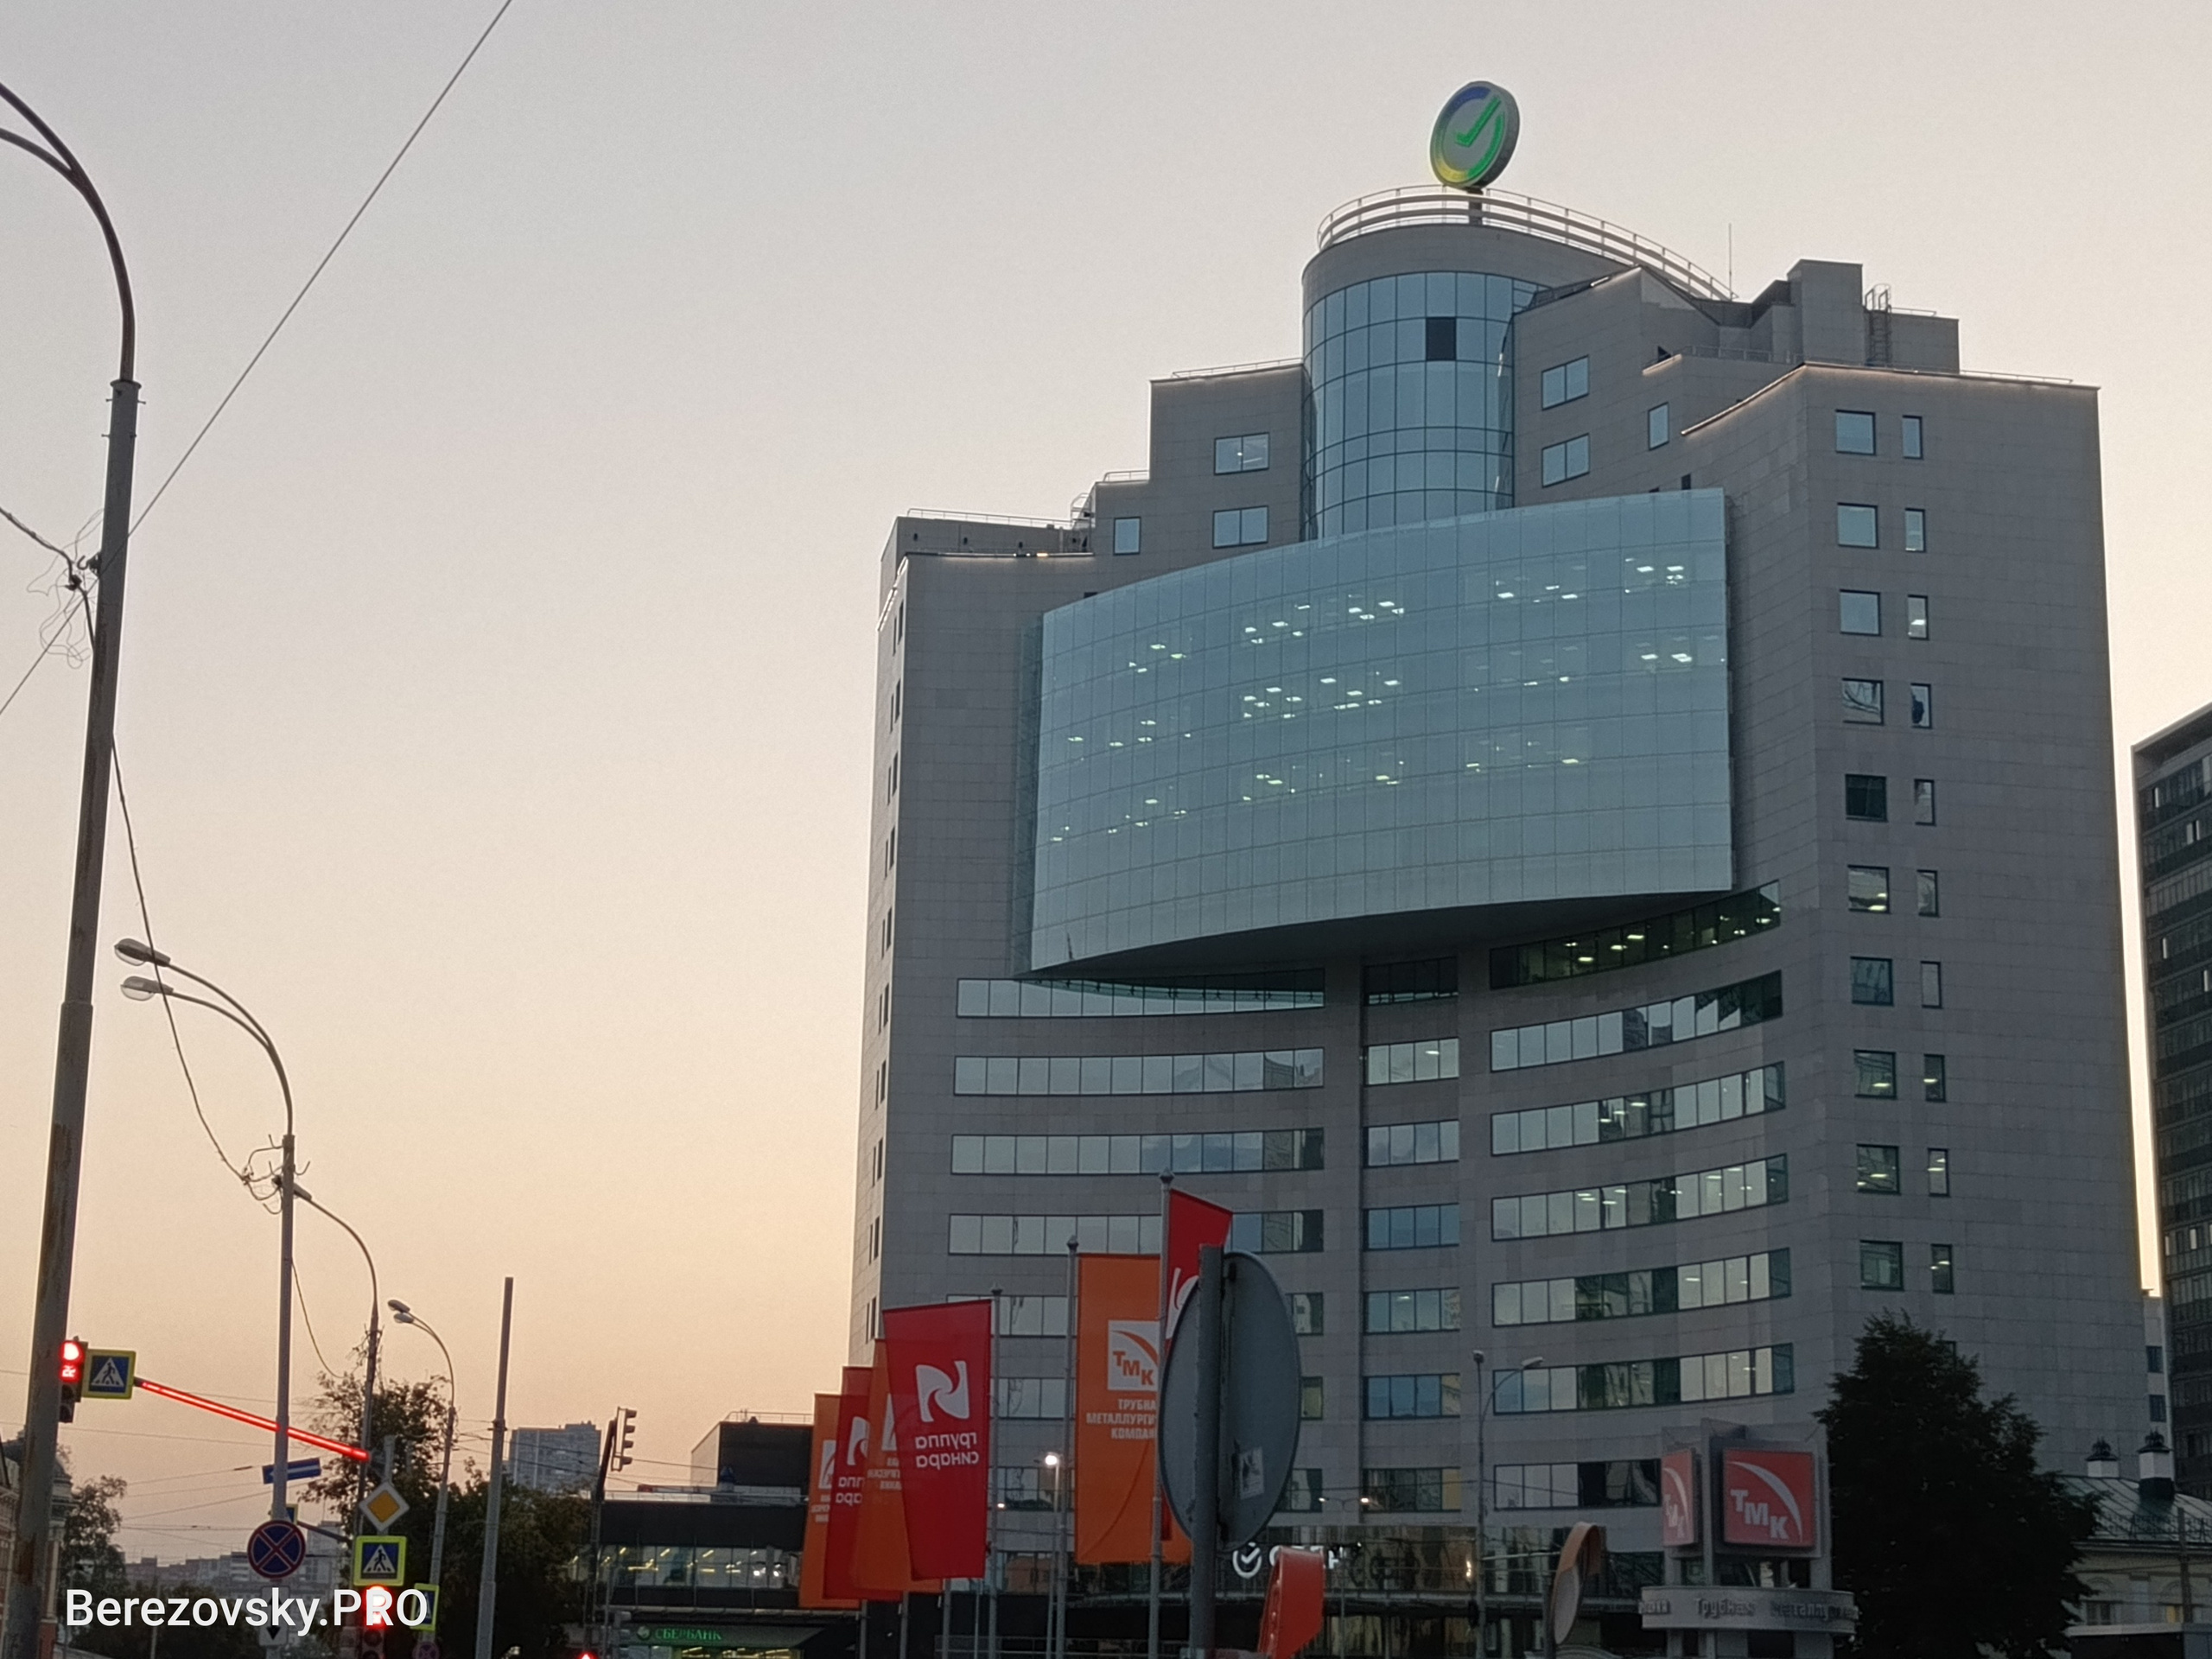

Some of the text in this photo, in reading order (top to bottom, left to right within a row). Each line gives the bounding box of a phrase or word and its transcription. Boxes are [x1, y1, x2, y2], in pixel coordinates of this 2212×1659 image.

[1113, 1351, 1154, 1386] ТМК
[1118, 1398, 1156, 1410] ТРУБНА
[1086, 1413, 1155, 1425] МЕТАЛЛУРГИ
[1111, 1427, 1156, 1440] КОМПАН
[1730, 1489, 1789, 1540] ТМК
[655, 1627, 722, 1641] СБЕРБАНК
